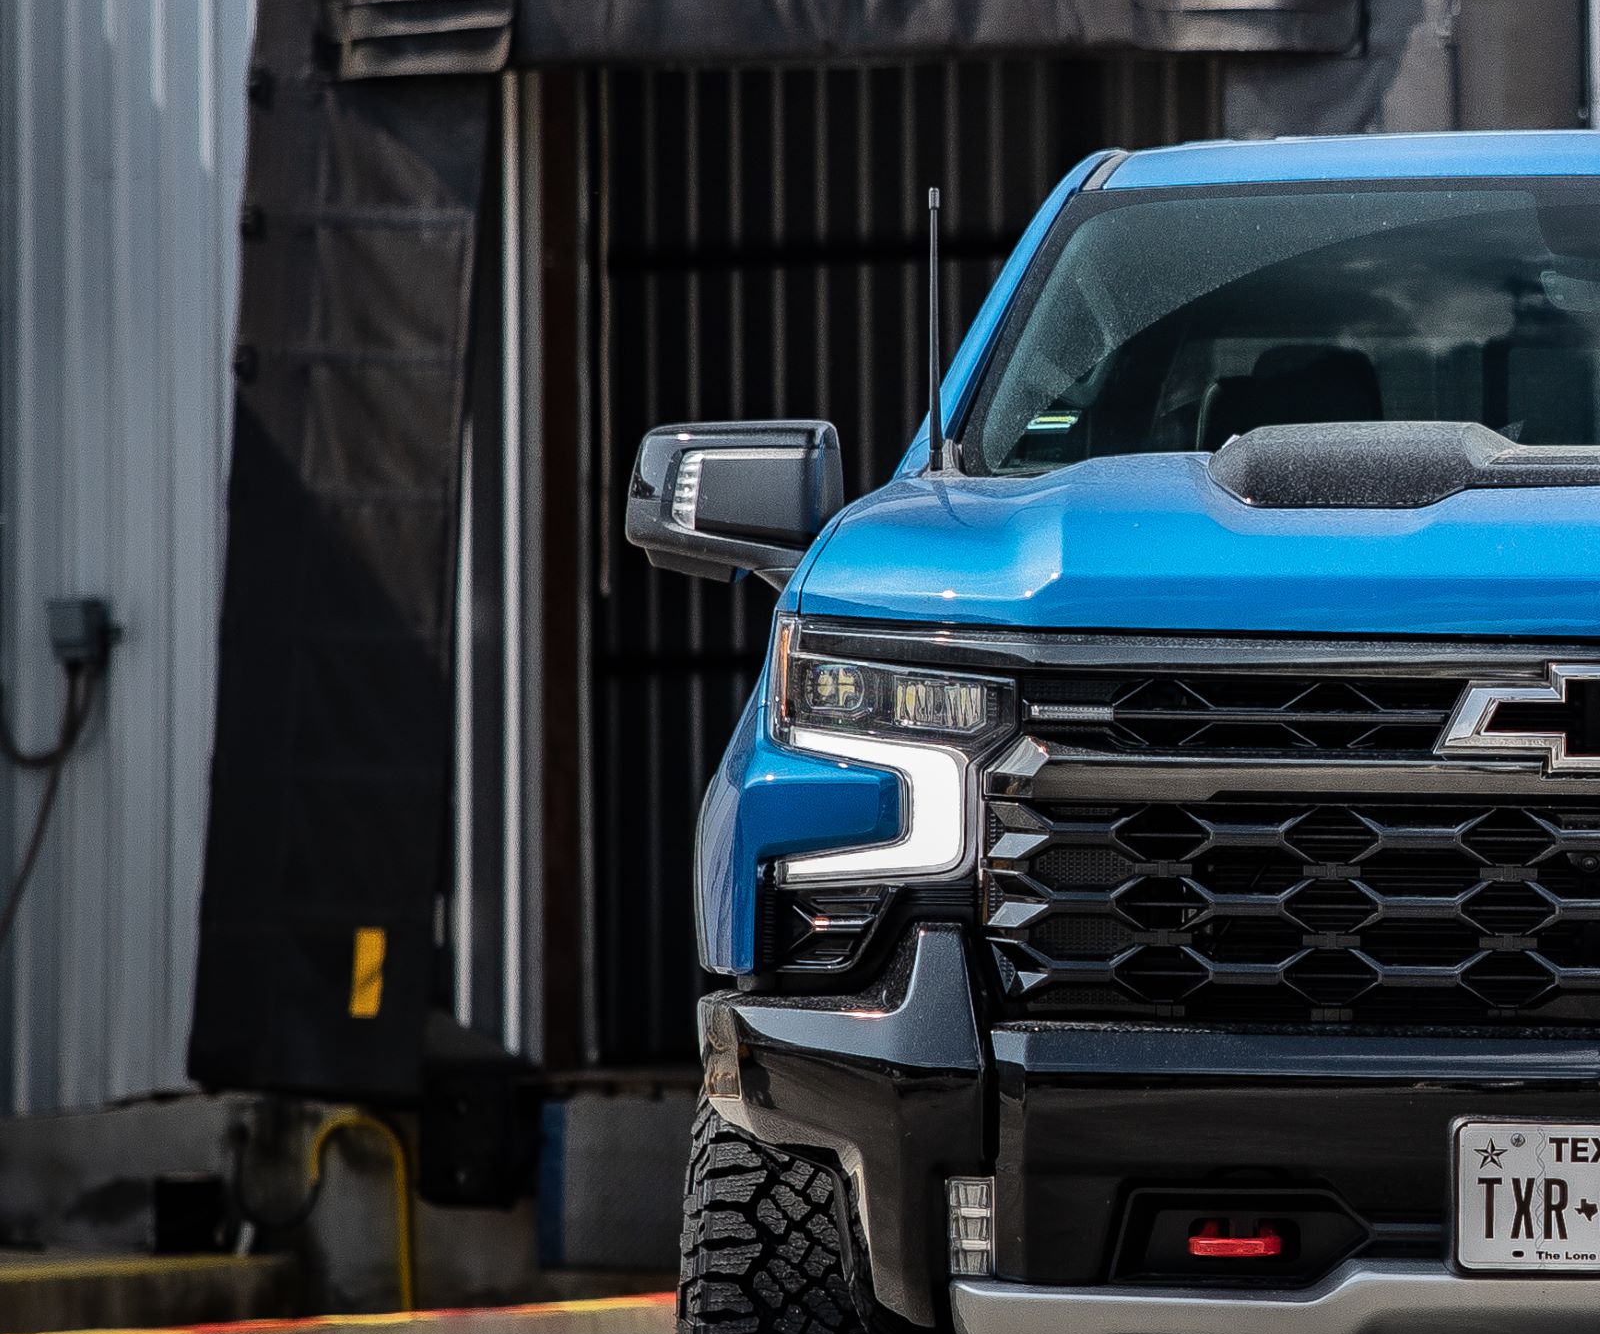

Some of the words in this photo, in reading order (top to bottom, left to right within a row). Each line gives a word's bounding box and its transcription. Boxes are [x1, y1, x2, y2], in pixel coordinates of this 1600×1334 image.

[1477, 1177, 1569, 1240] TXR
[1536, 1251, 1561, 1261] The
[1565, 1251, 1597, 1261] Lone
